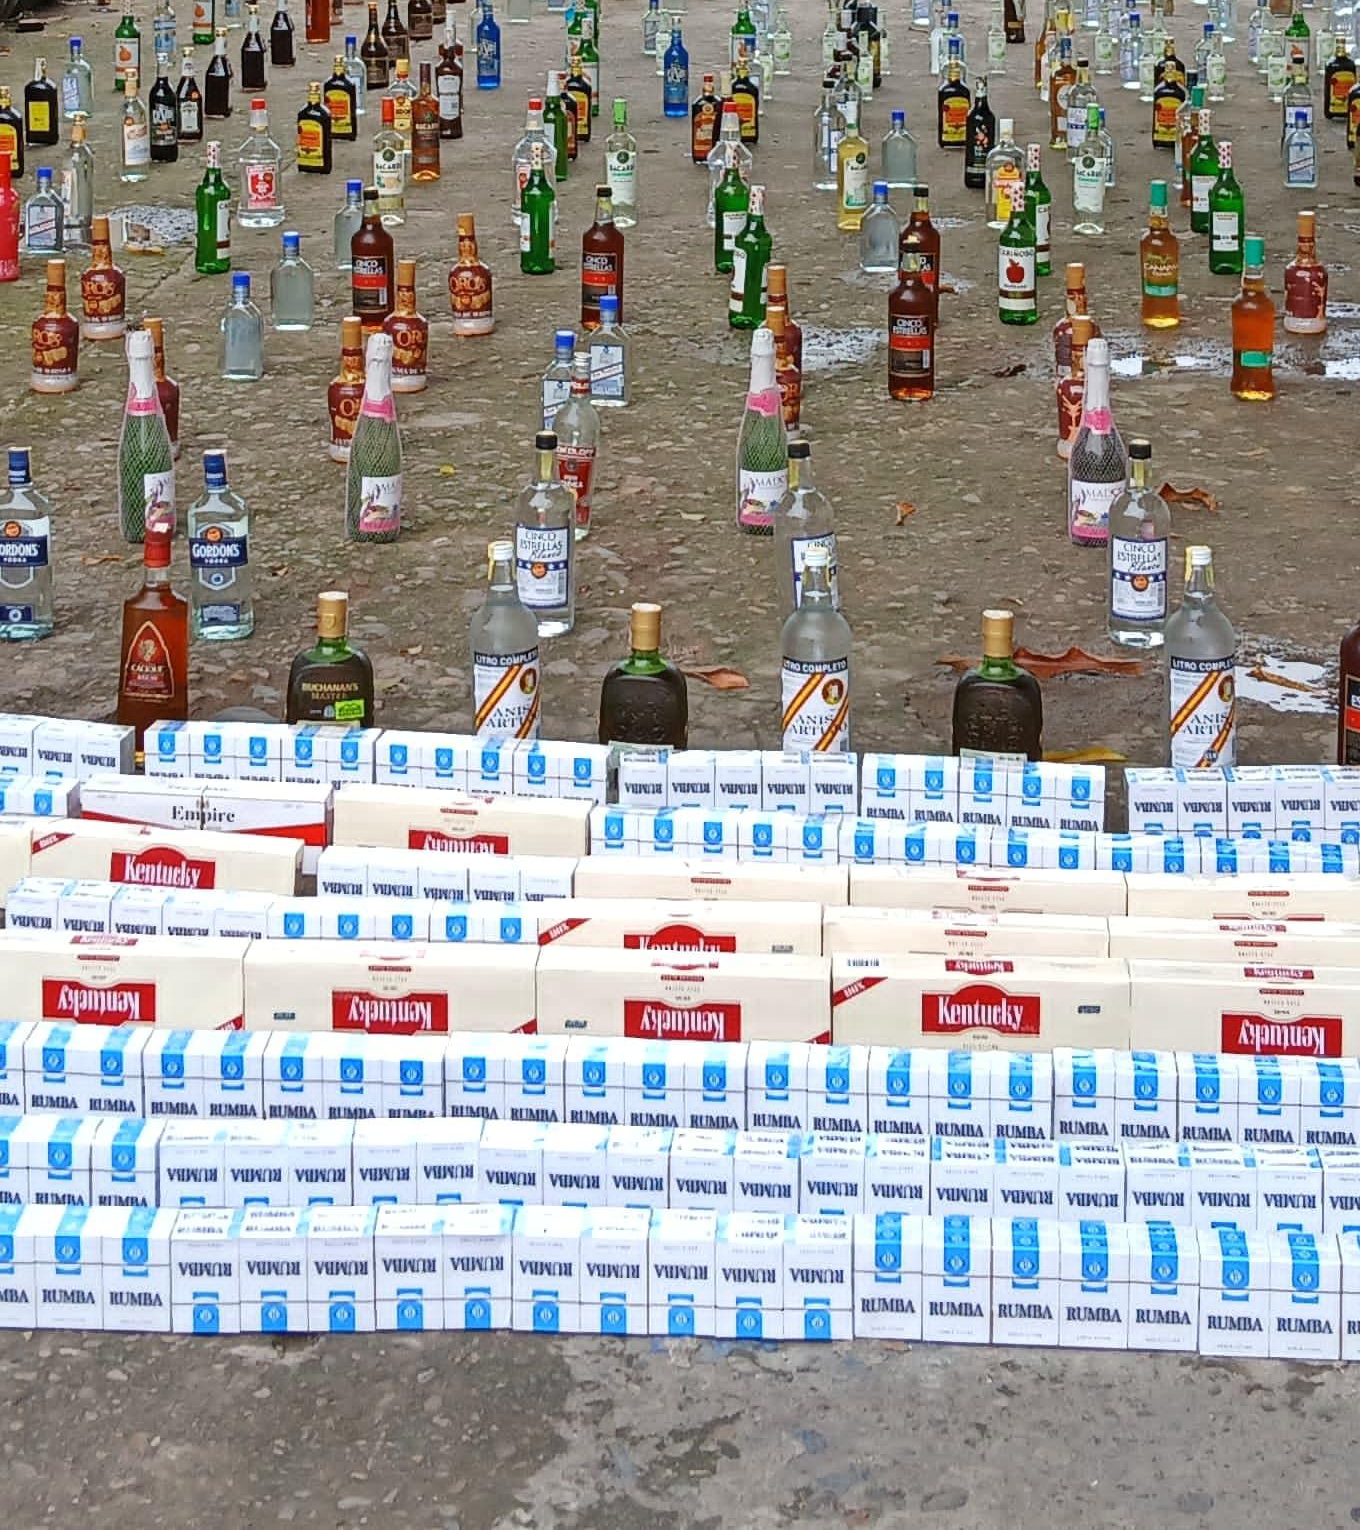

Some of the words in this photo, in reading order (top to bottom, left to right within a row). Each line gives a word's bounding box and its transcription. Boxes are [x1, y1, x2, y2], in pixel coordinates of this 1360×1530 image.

[192, 544, 240, 558] GORDON'S
[1123, 543, 1156, 552] CINCO
[802, 660, 846, 673] COMPLETO
[172, 805, 235, 830] Empire
[124, 858, 202, 889] Kentucky
[57, 981, 141, 1018] Kentucky
[348, 993, 434, 1031] Kentucky
[936, 994, 1025, 1029] Kentucky
[638, 1011, 724, 1041] Kentucky
[1238, 1018, 1326, 1055] Kentucky
[424, 1166, 473, 1179] RUMBA
[1198, 1192, 1250, 1207] RUMBA
[451, 1257, 503, 1271] RUMBA
[722, 1269, 775, 1283] RUMBA
[43, 1289, 95, 1304] RUMBA
[1136, 1309, 1190, 1324] RUMBA
